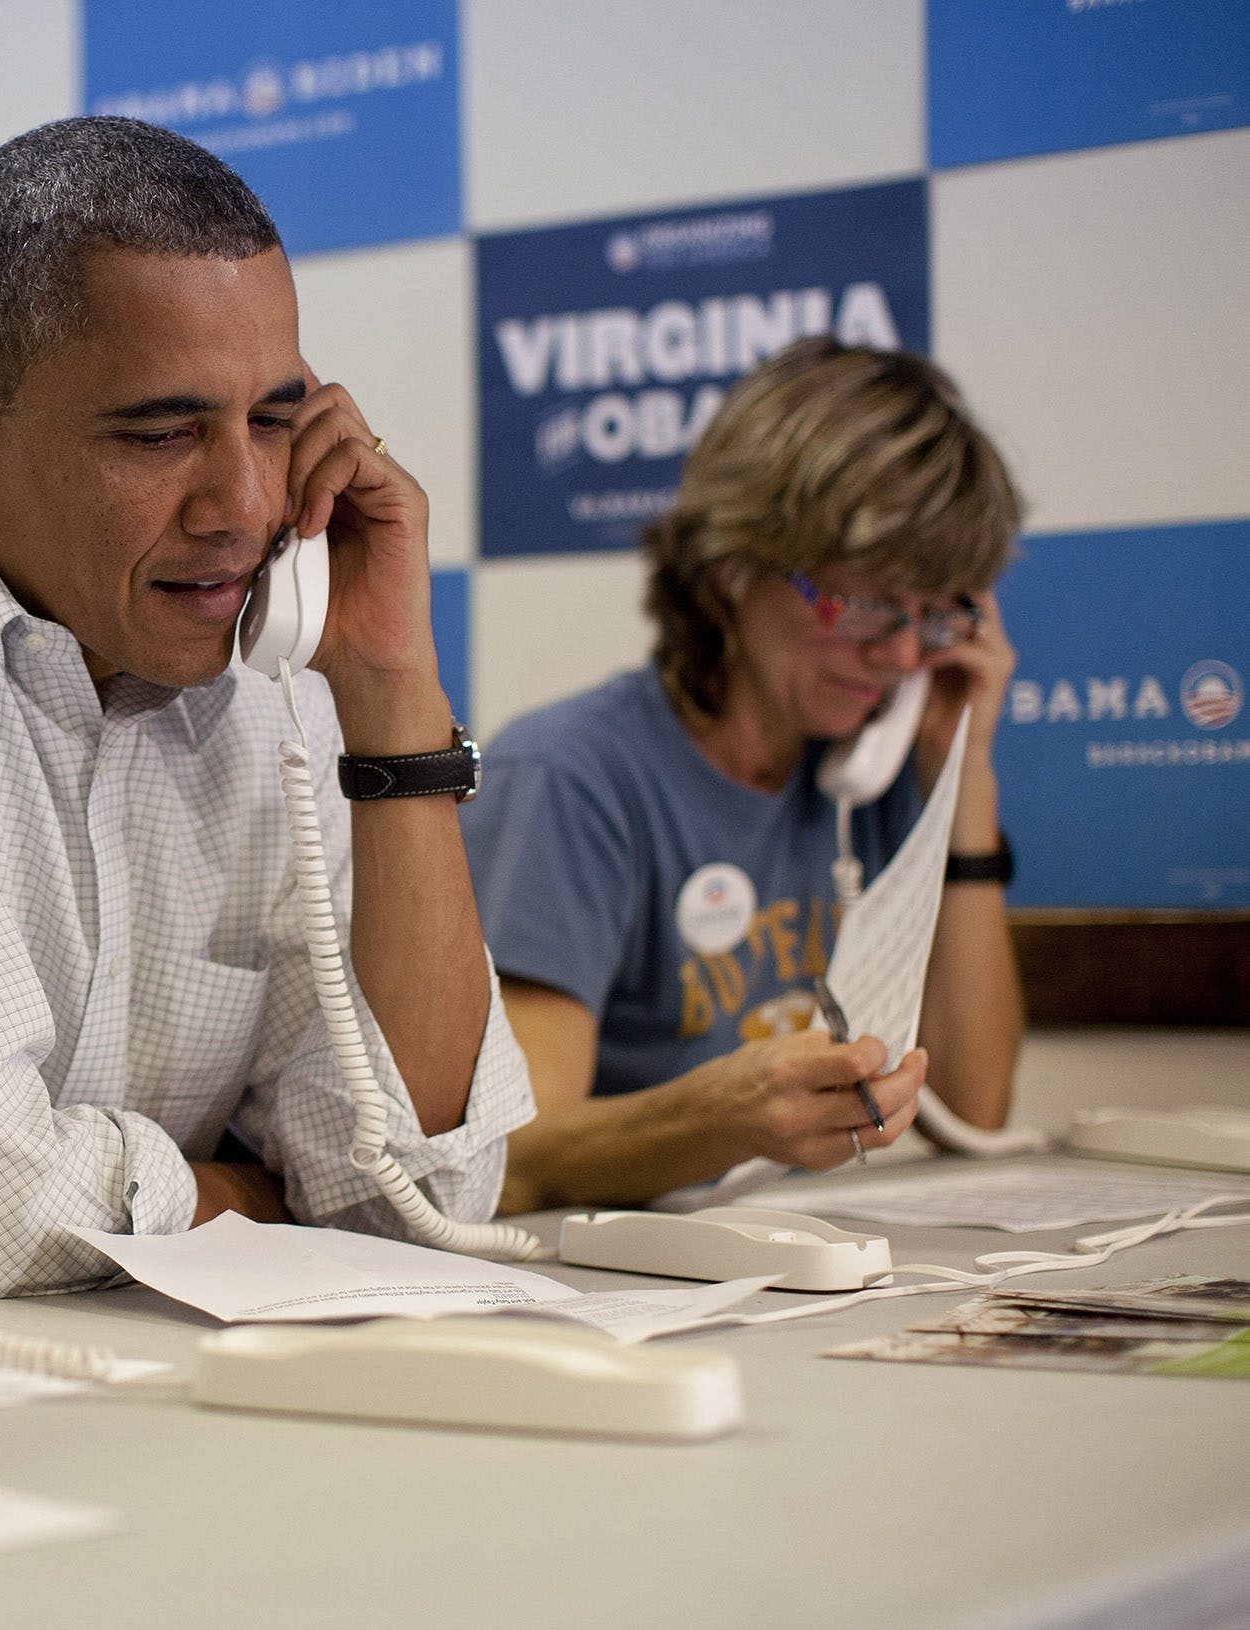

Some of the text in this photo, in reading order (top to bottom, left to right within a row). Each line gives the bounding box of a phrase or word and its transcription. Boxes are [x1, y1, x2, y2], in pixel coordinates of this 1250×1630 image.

[496, 282, 899, 394] VIRGINIA
[580, 385, 726, 462] OBA
[1010, 676, 1170, 724] BAMA
